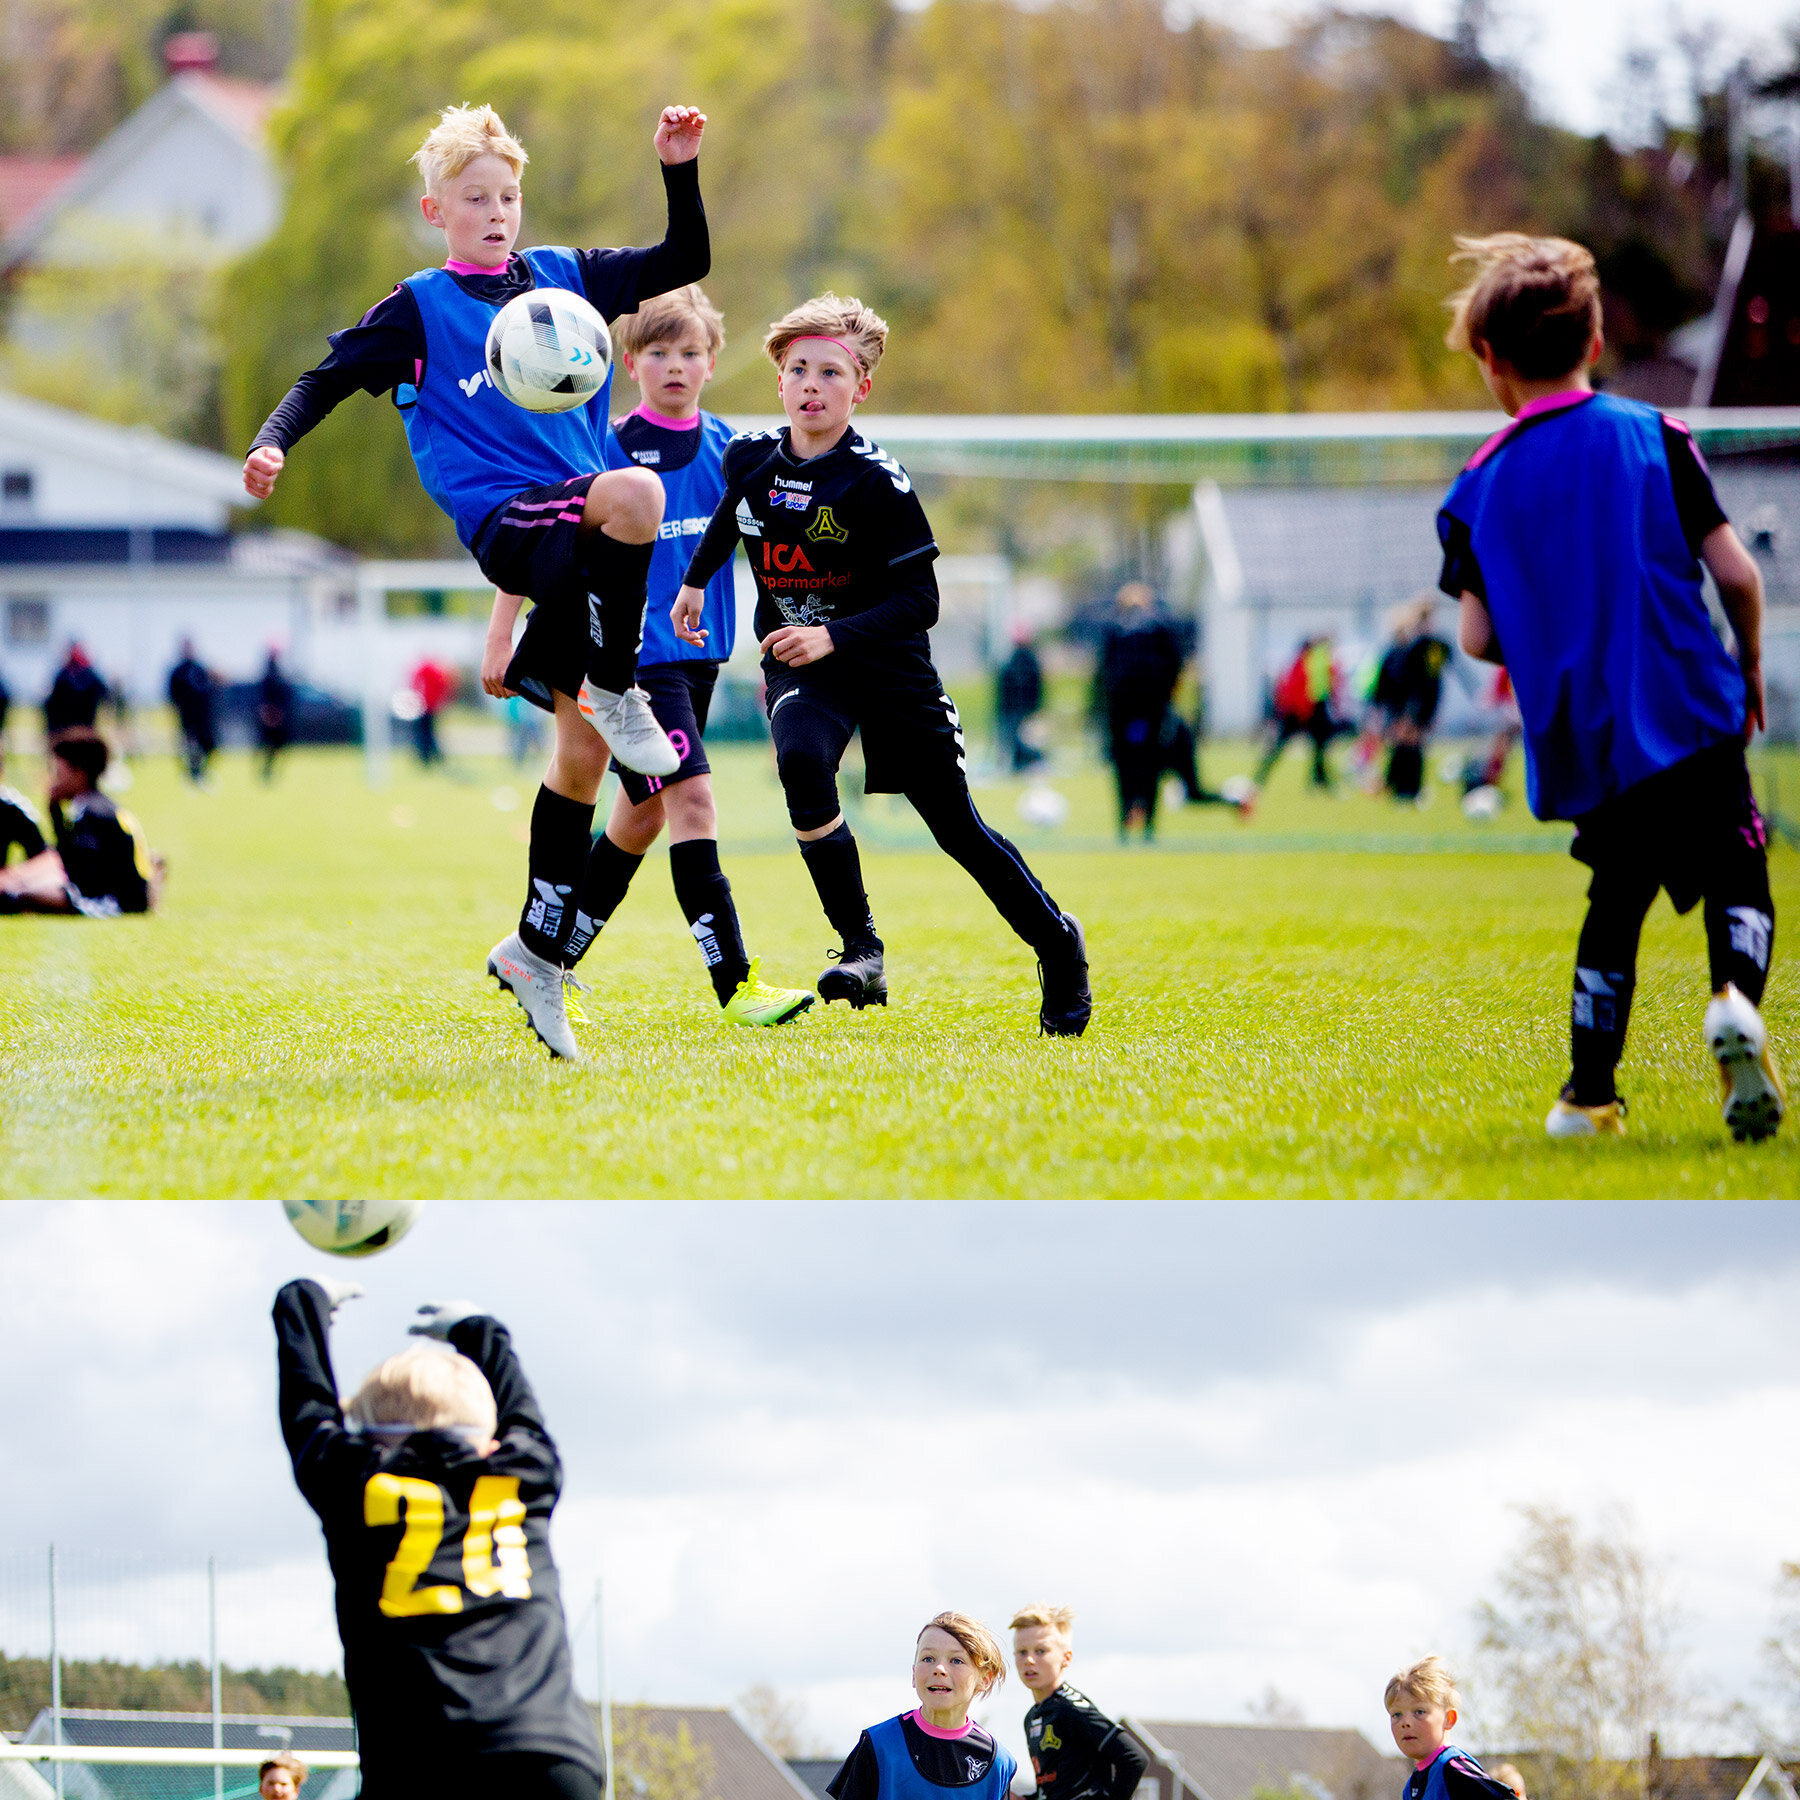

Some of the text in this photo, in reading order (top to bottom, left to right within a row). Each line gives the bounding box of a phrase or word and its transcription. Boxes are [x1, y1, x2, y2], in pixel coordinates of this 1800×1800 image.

[774, 475, 813, 492] hummel
[785, 492, 812, 503] INTER
[785, 501, 808, 511] SPORT
[763, 542, 815, 573] ICA
[668, 729, 691, 762] 9
[542, 905, 564, 938] INTER
[564, 930, 592, 956] INTER
[702, 934, 724, 966] INTER
[364, 1472, 533, 1618] 24
